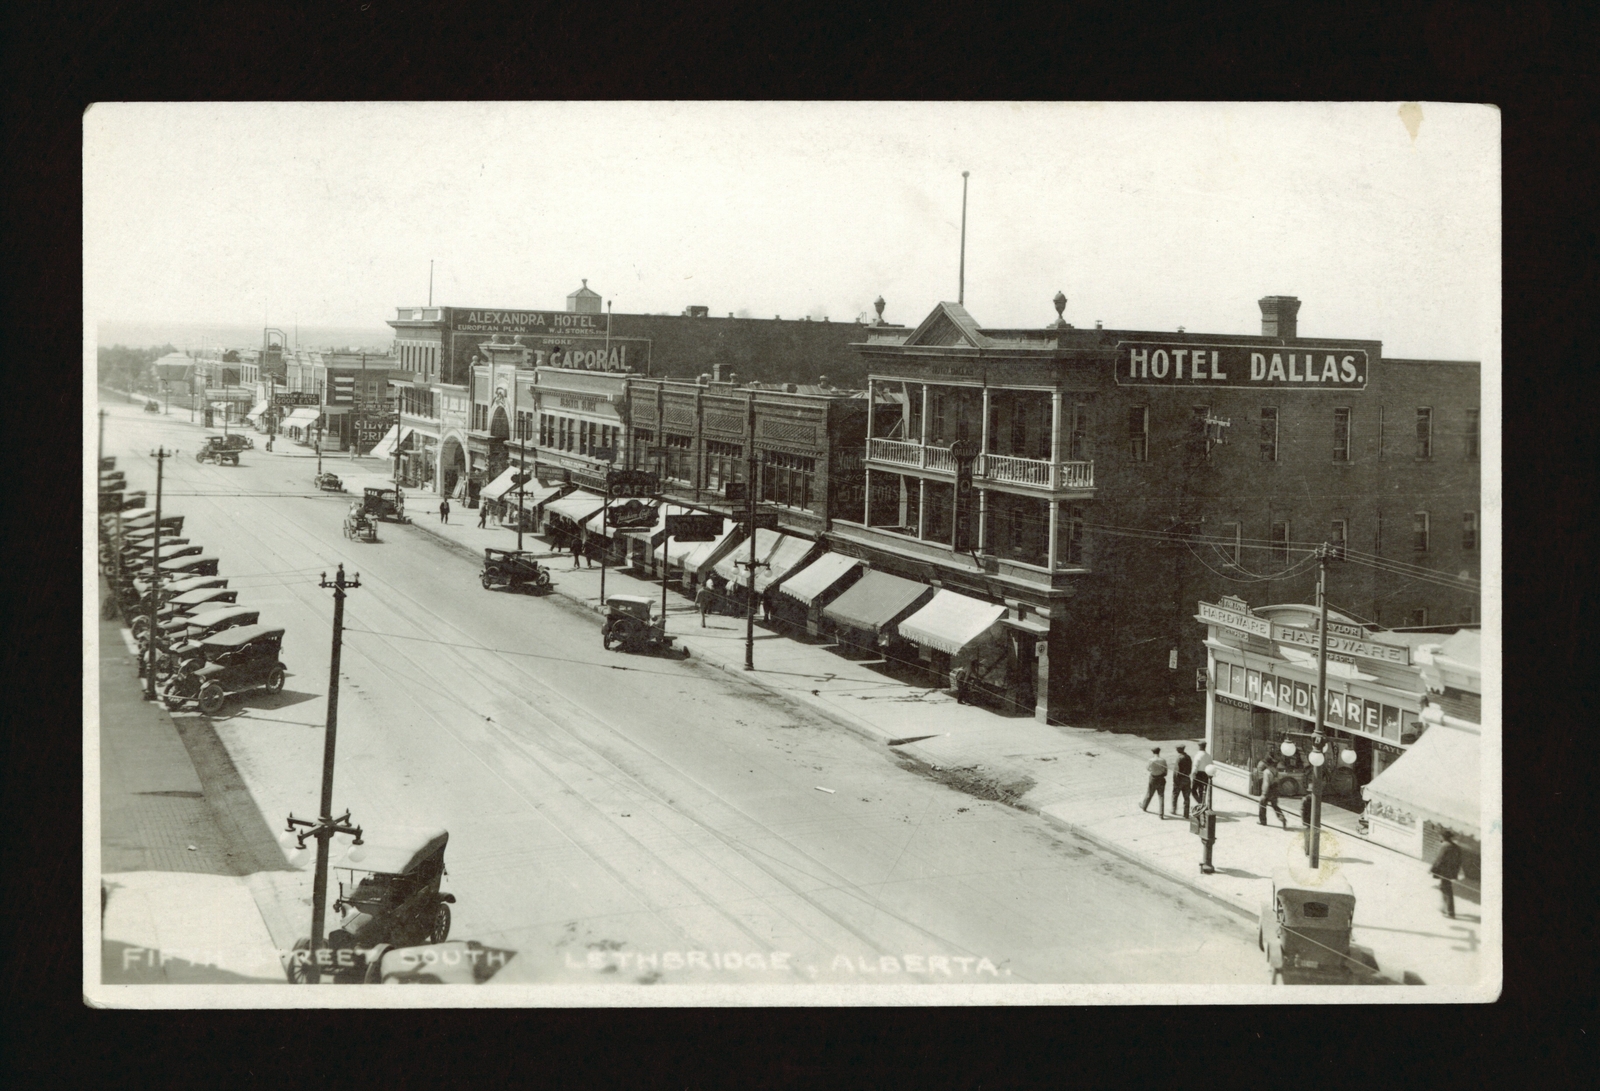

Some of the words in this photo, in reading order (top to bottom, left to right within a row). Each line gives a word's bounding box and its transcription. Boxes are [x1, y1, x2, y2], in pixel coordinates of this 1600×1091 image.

[468, 311, 545, 326] ALEXANDRA
[554, 315, 597, 328] HOTEL
[457, 324, 499, 332] EUROPEAN
[550, 345, 630, 370] CAPORAL
[1130, 349, 1227, 380] HOTEL
[1250, 352, 1364, 384] DALLAS.
[354, 420, 393, 430] SILVE
[955, 448, 978, 457] DALLAS
[611, 484, 654, 496] CAFE
[959, 461, 971, 549] HOTEL
[1203, 605, 1267, 635] HARDWARE
[1326, 623, 1358, 637] AYLOR
[1218, 695, 1250, 710] TAYLOR
[1248, 674, 1379, 728] HARDARE
[1377, 742, 1406, 756] TAYL
